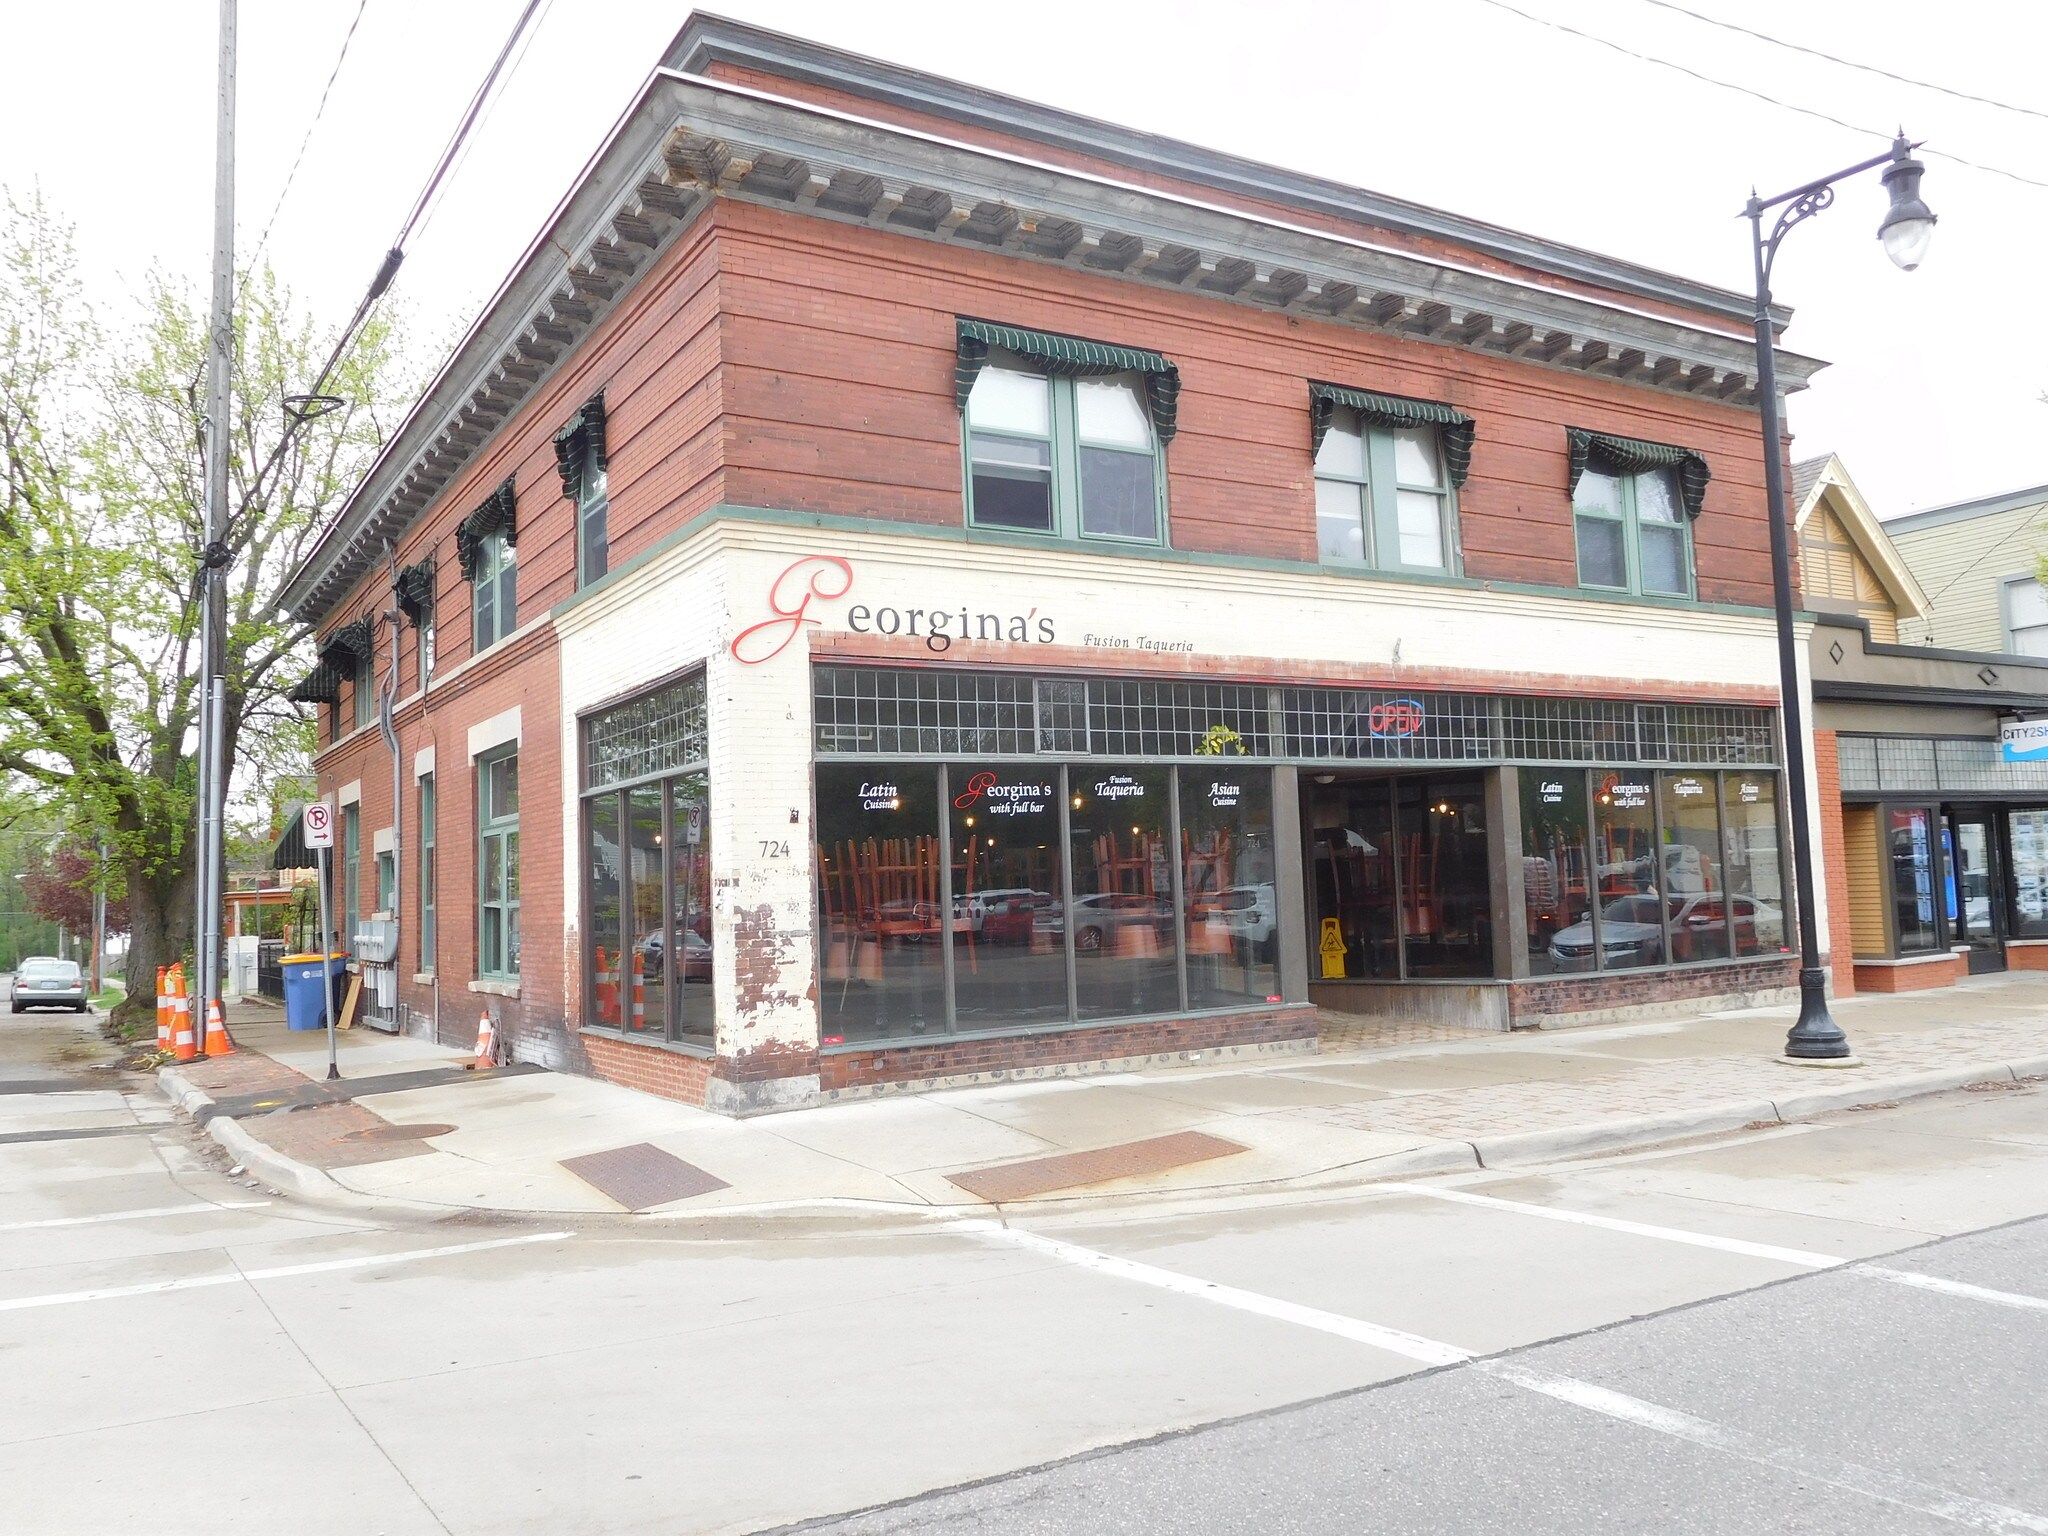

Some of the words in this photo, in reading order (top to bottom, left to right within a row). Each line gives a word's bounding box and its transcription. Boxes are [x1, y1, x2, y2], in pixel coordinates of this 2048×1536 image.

[731, 555, 1056, 664] Georgina's
[1083, 634, 1130, 648] Fusion
[1136, 636, 1194, 654] Taqueria
[1370, 705, 1420, 732] OPEN
[1109, 775, 1133, 784] Fusion
[1540, 781, 1563, 793] Latin
[858, 782, 898, 797] Latin
[954, 771, 1052, 809] Georgina's
[1094, 782, 1144, 800] Taqueria
[1207, 782, 1240, 797] Asian
[989, 803, 1011, 814] with
[1010, 802, 1028, 817] full
[1029, 802, 1045, 813] bar
[1212, 797, 1237, 807] Cuisine
[758, 840, 790, 858] 724
